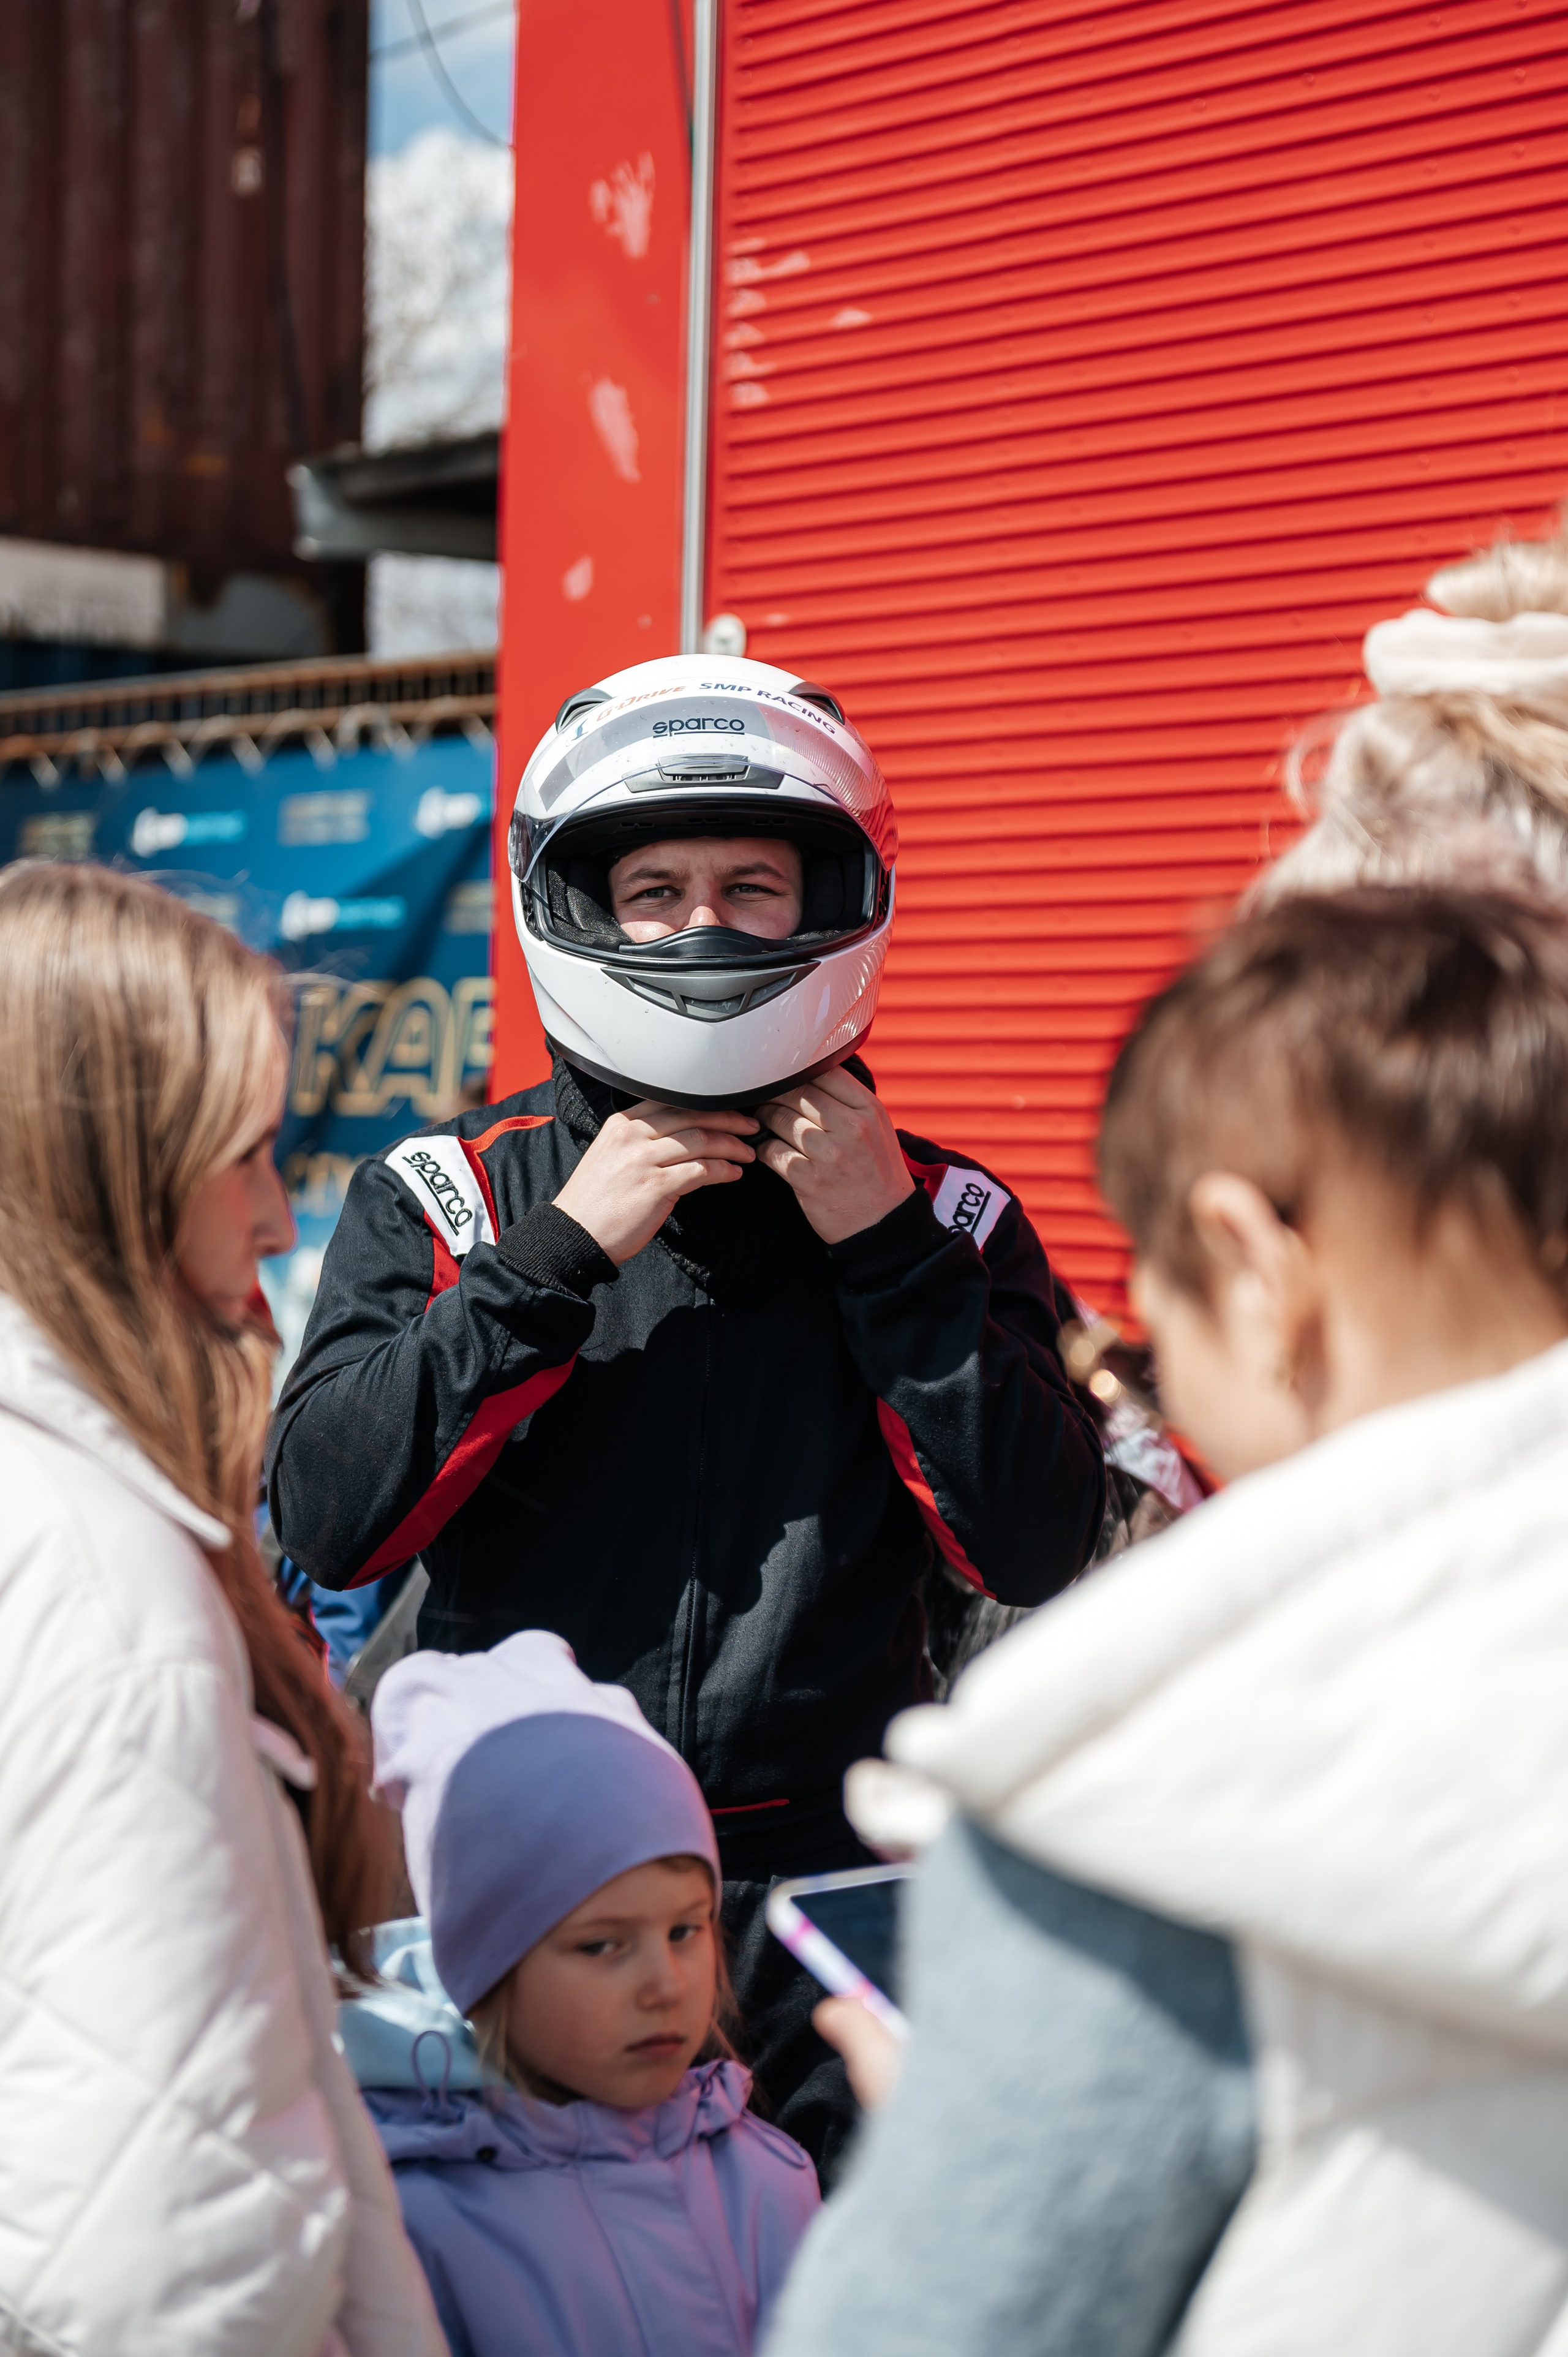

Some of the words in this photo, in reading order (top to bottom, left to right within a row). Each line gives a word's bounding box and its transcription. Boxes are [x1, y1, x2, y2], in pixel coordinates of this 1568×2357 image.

[652, 717, 745, 737] sparco
[699, 682, 752, 692] SMP
[756, 690, 835, 734] RACING
[410, 1151, 473, 1228] sparco
[948, 1182, 986, 1235] arco
